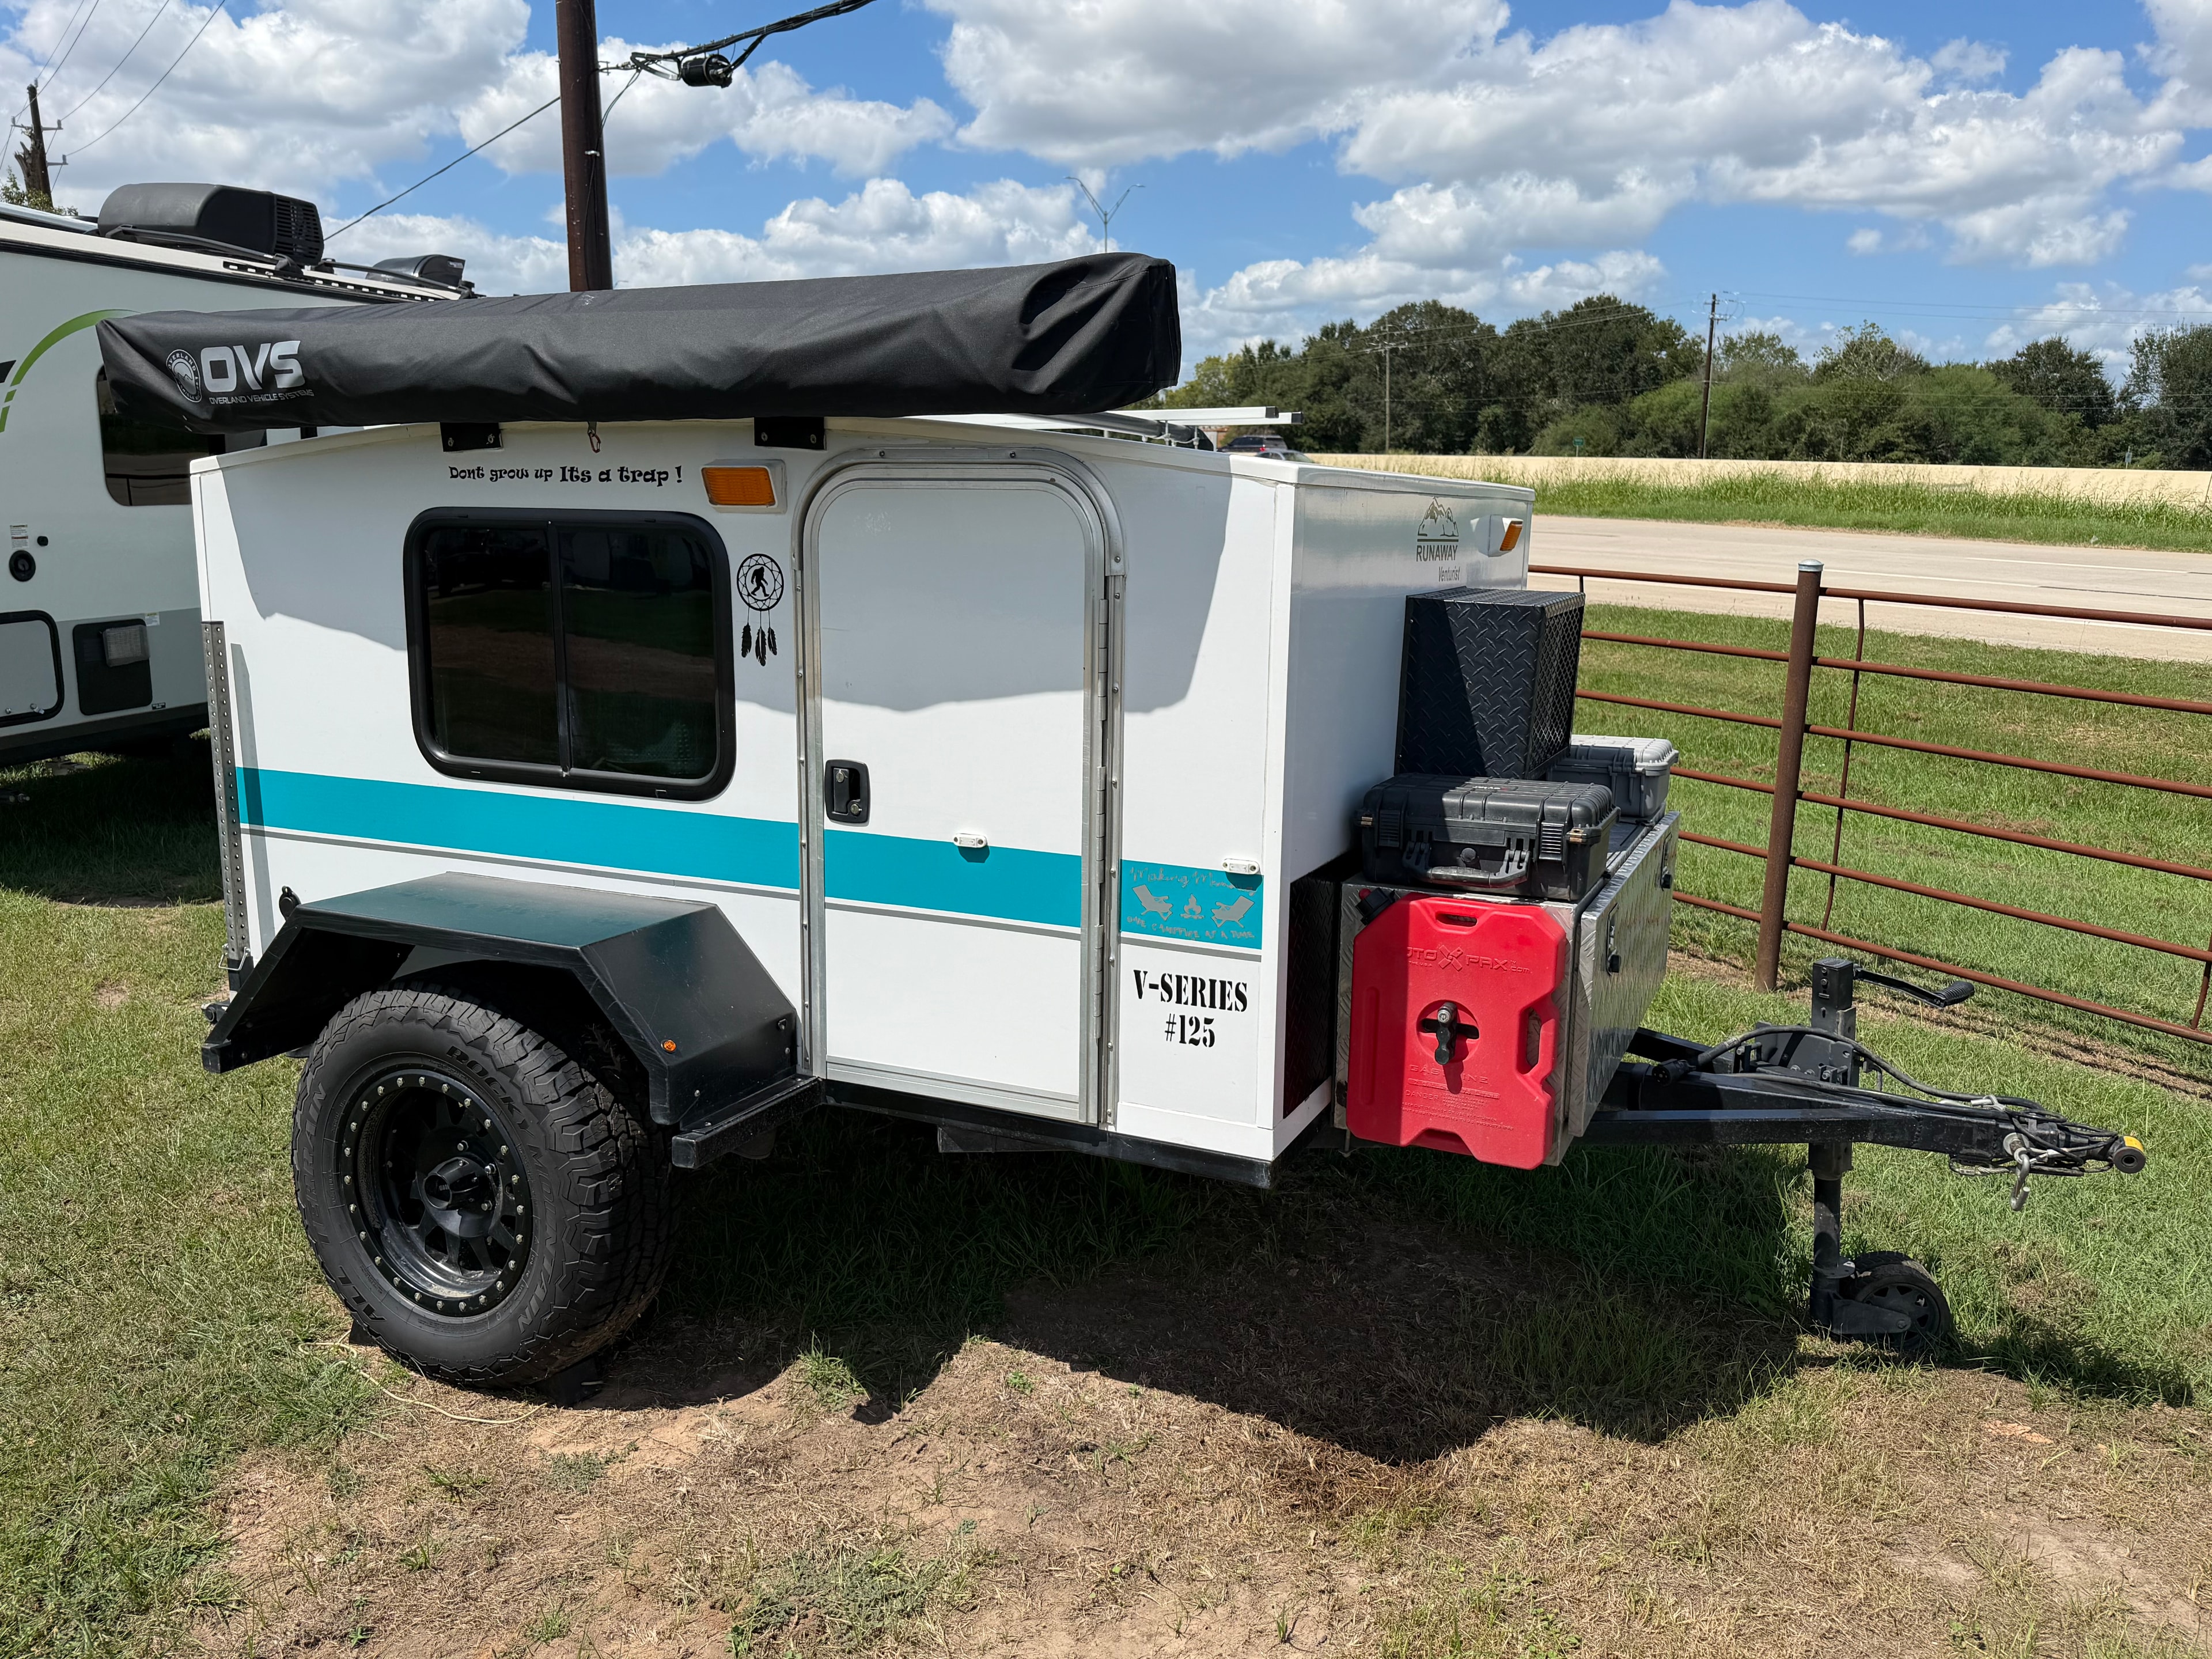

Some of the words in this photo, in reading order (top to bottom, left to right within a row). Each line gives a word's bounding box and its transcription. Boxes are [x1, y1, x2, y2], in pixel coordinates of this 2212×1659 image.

[200, 340, 305, 392] OVS
[209, 395, 247, 405] OVERLAND
[248, 393, 279, 403] VEHICLE
[279, 389, 315, 401] SYSTEMS
[448, 465, 485, 480] Dont
[490, 467, 529, 482] grow
[534, 468, 554, 482] up
[560, 465, 592, 483] Its
[598, 468, 612, 483] a
[618, 467, 669, 487] trap
[1416, 544, 1458, 562] RUNAWAY
[1438, 566, 1460, 582] Venturist
[1151, 922, 1201, 940] CAMPFIRE
[1205, 930, 1217, 940] AT
[1230, 930, 1255, 940] TIME
[1133, 969, 1248, 1012] V-SERIES
[1164, 1013, 1215, 1048] #125
[1410, 1064, 1488, 1084] GASINE
[1406, 1089, 1439, 1100] DANGER
[302, 1082, 327, 1246] TERRAIN
[446, 1046, 537, 1137] ROCKY
[518, 1145, 558, 1334] MOUNTAIN
[340, 1265, 387, 1324] ALL
